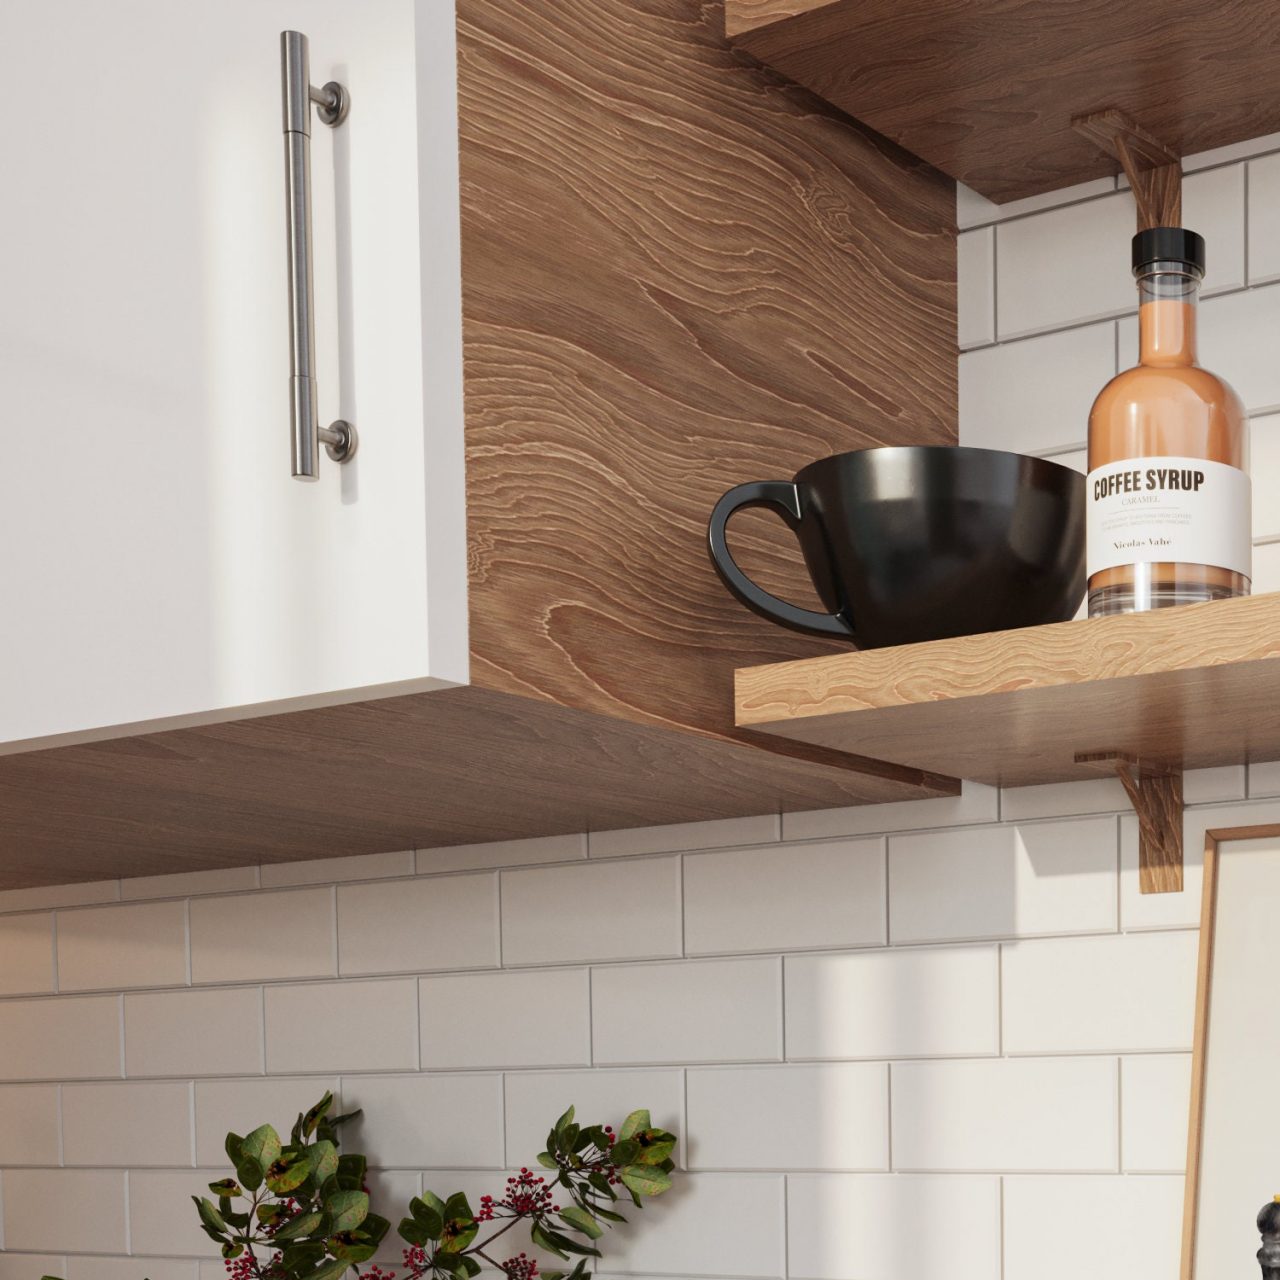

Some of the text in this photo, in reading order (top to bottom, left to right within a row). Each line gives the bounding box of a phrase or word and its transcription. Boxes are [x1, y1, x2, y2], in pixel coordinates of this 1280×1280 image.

[1094, 469, 1205, 501] COFFEE SYRUP
[1113, 538, 1146, 550] Nicolas
